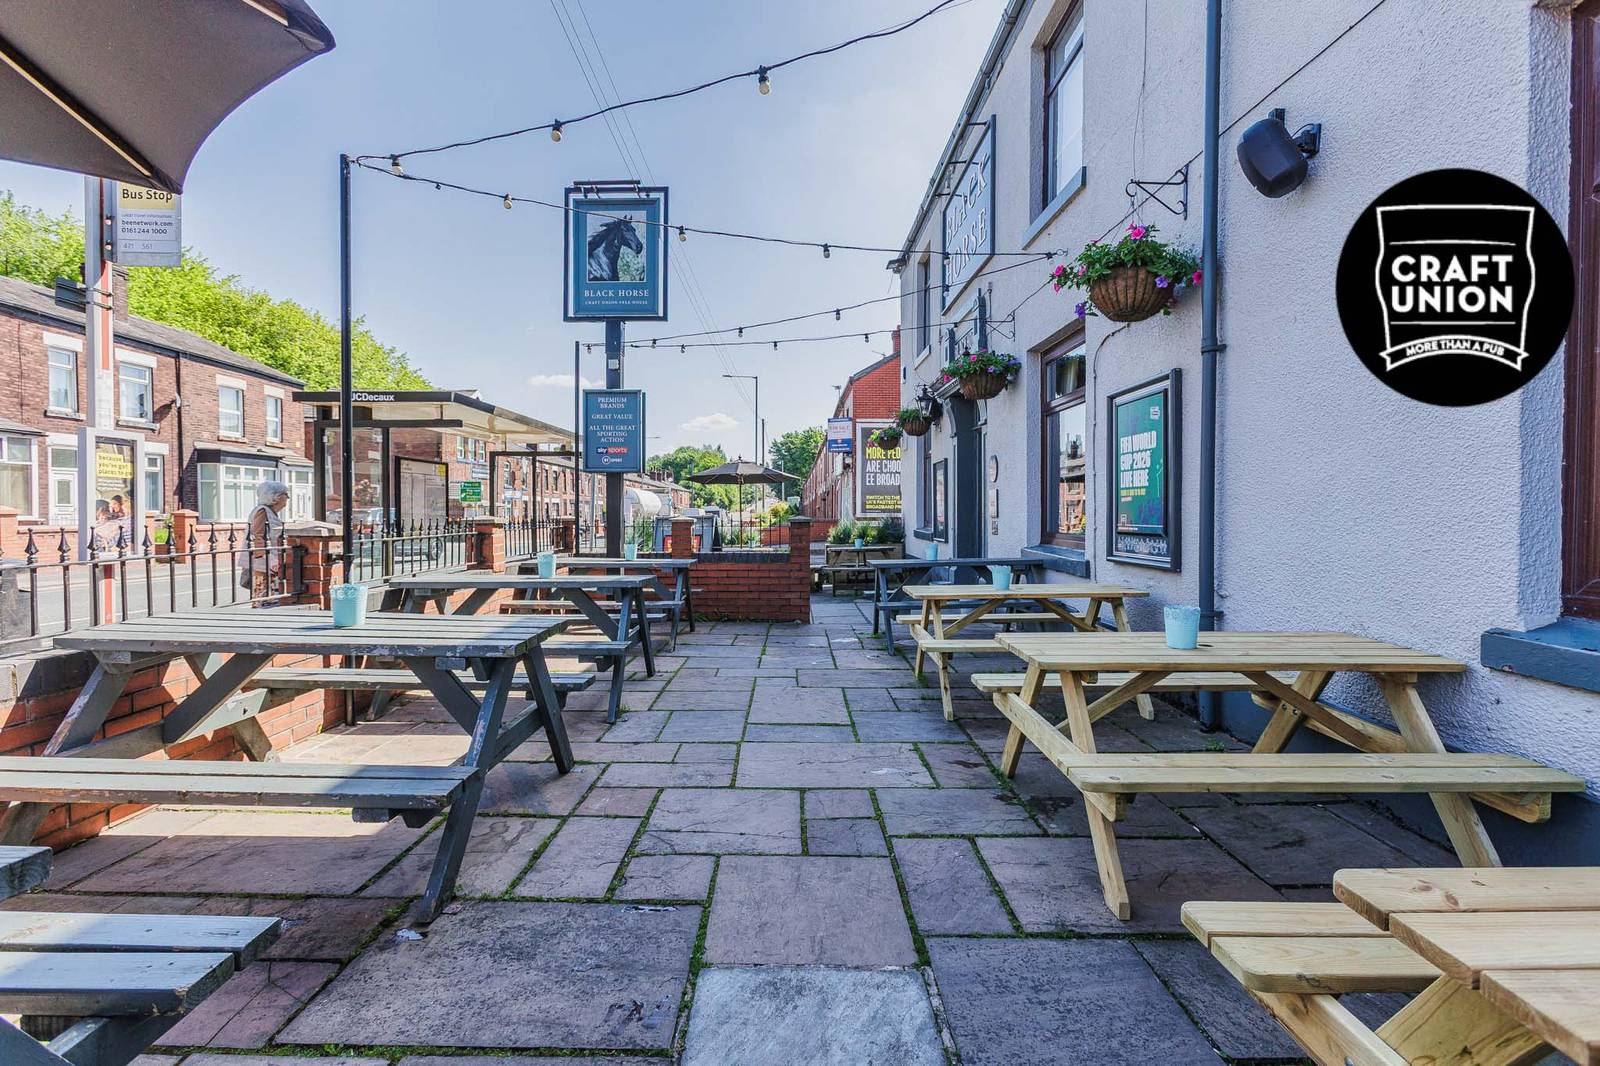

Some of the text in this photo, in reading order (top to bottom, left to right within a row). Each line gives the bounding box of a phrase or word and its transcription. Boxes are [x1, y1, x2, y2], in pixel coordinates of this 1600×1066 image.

[122, 188, 173, 203] Bus Stop
[946, 152, 990, 248] BLACK
[945, 207, 987, 286] HORSE
[584, 289, 649, 297] BLACK HORSE
[351, 392, 396, 402] JCDecaux
[1120, 431, 1157, 454] FIFA WORLD
[597, 447, 608, 455] sky
[865, 447, 886, 459] MORE
[865, 460, 881, 473] ARE
[1120, 453, 1133, 471] CUP
[865, 473, 900, 486] EE BROAD
[1120, 468, 1149, 488] LIVE HERE
